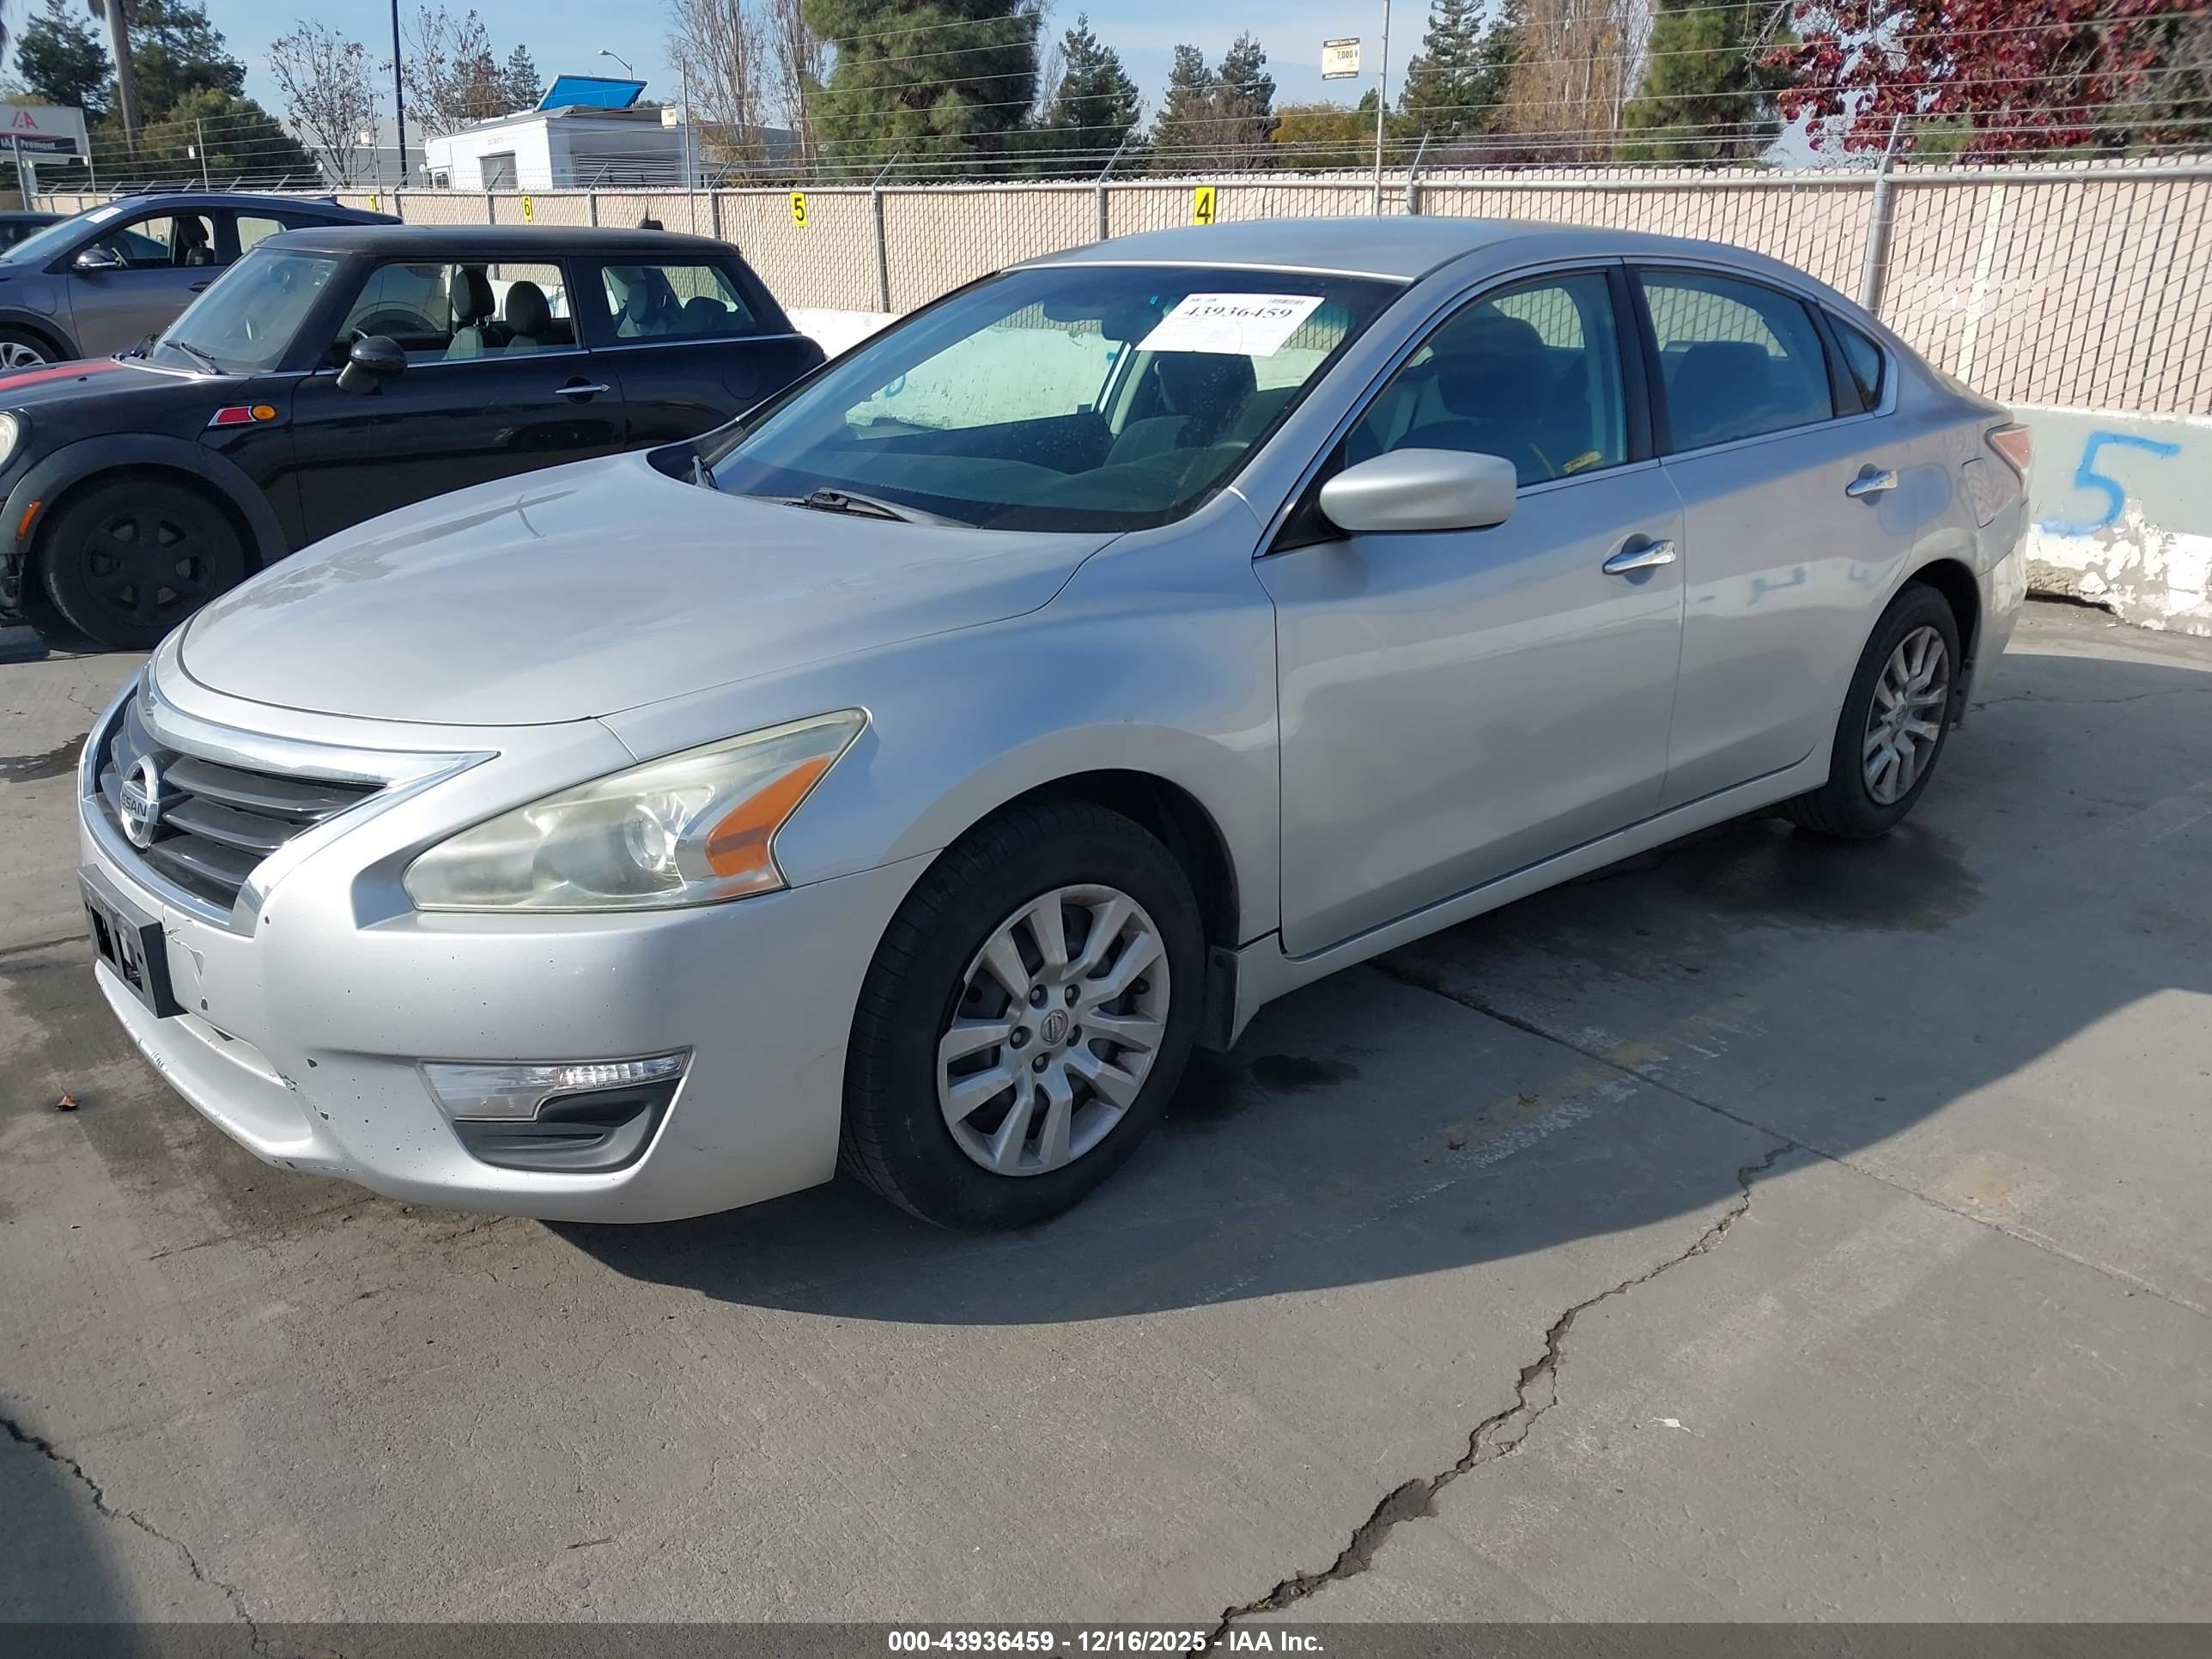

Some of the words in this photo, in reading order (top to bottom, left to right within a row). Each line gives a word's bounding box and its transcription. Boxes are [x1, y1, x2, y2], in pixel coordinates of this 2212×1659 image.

[524, 198, 531, 216] 6
[794, 197, 805, 222] 5
[1196, 191, 1212, 224] 4
[1184, 306, 1293, 319] 43936459
[2041, 431, 2181, 536] 5
[121, 792, 148, 817] SSAN
